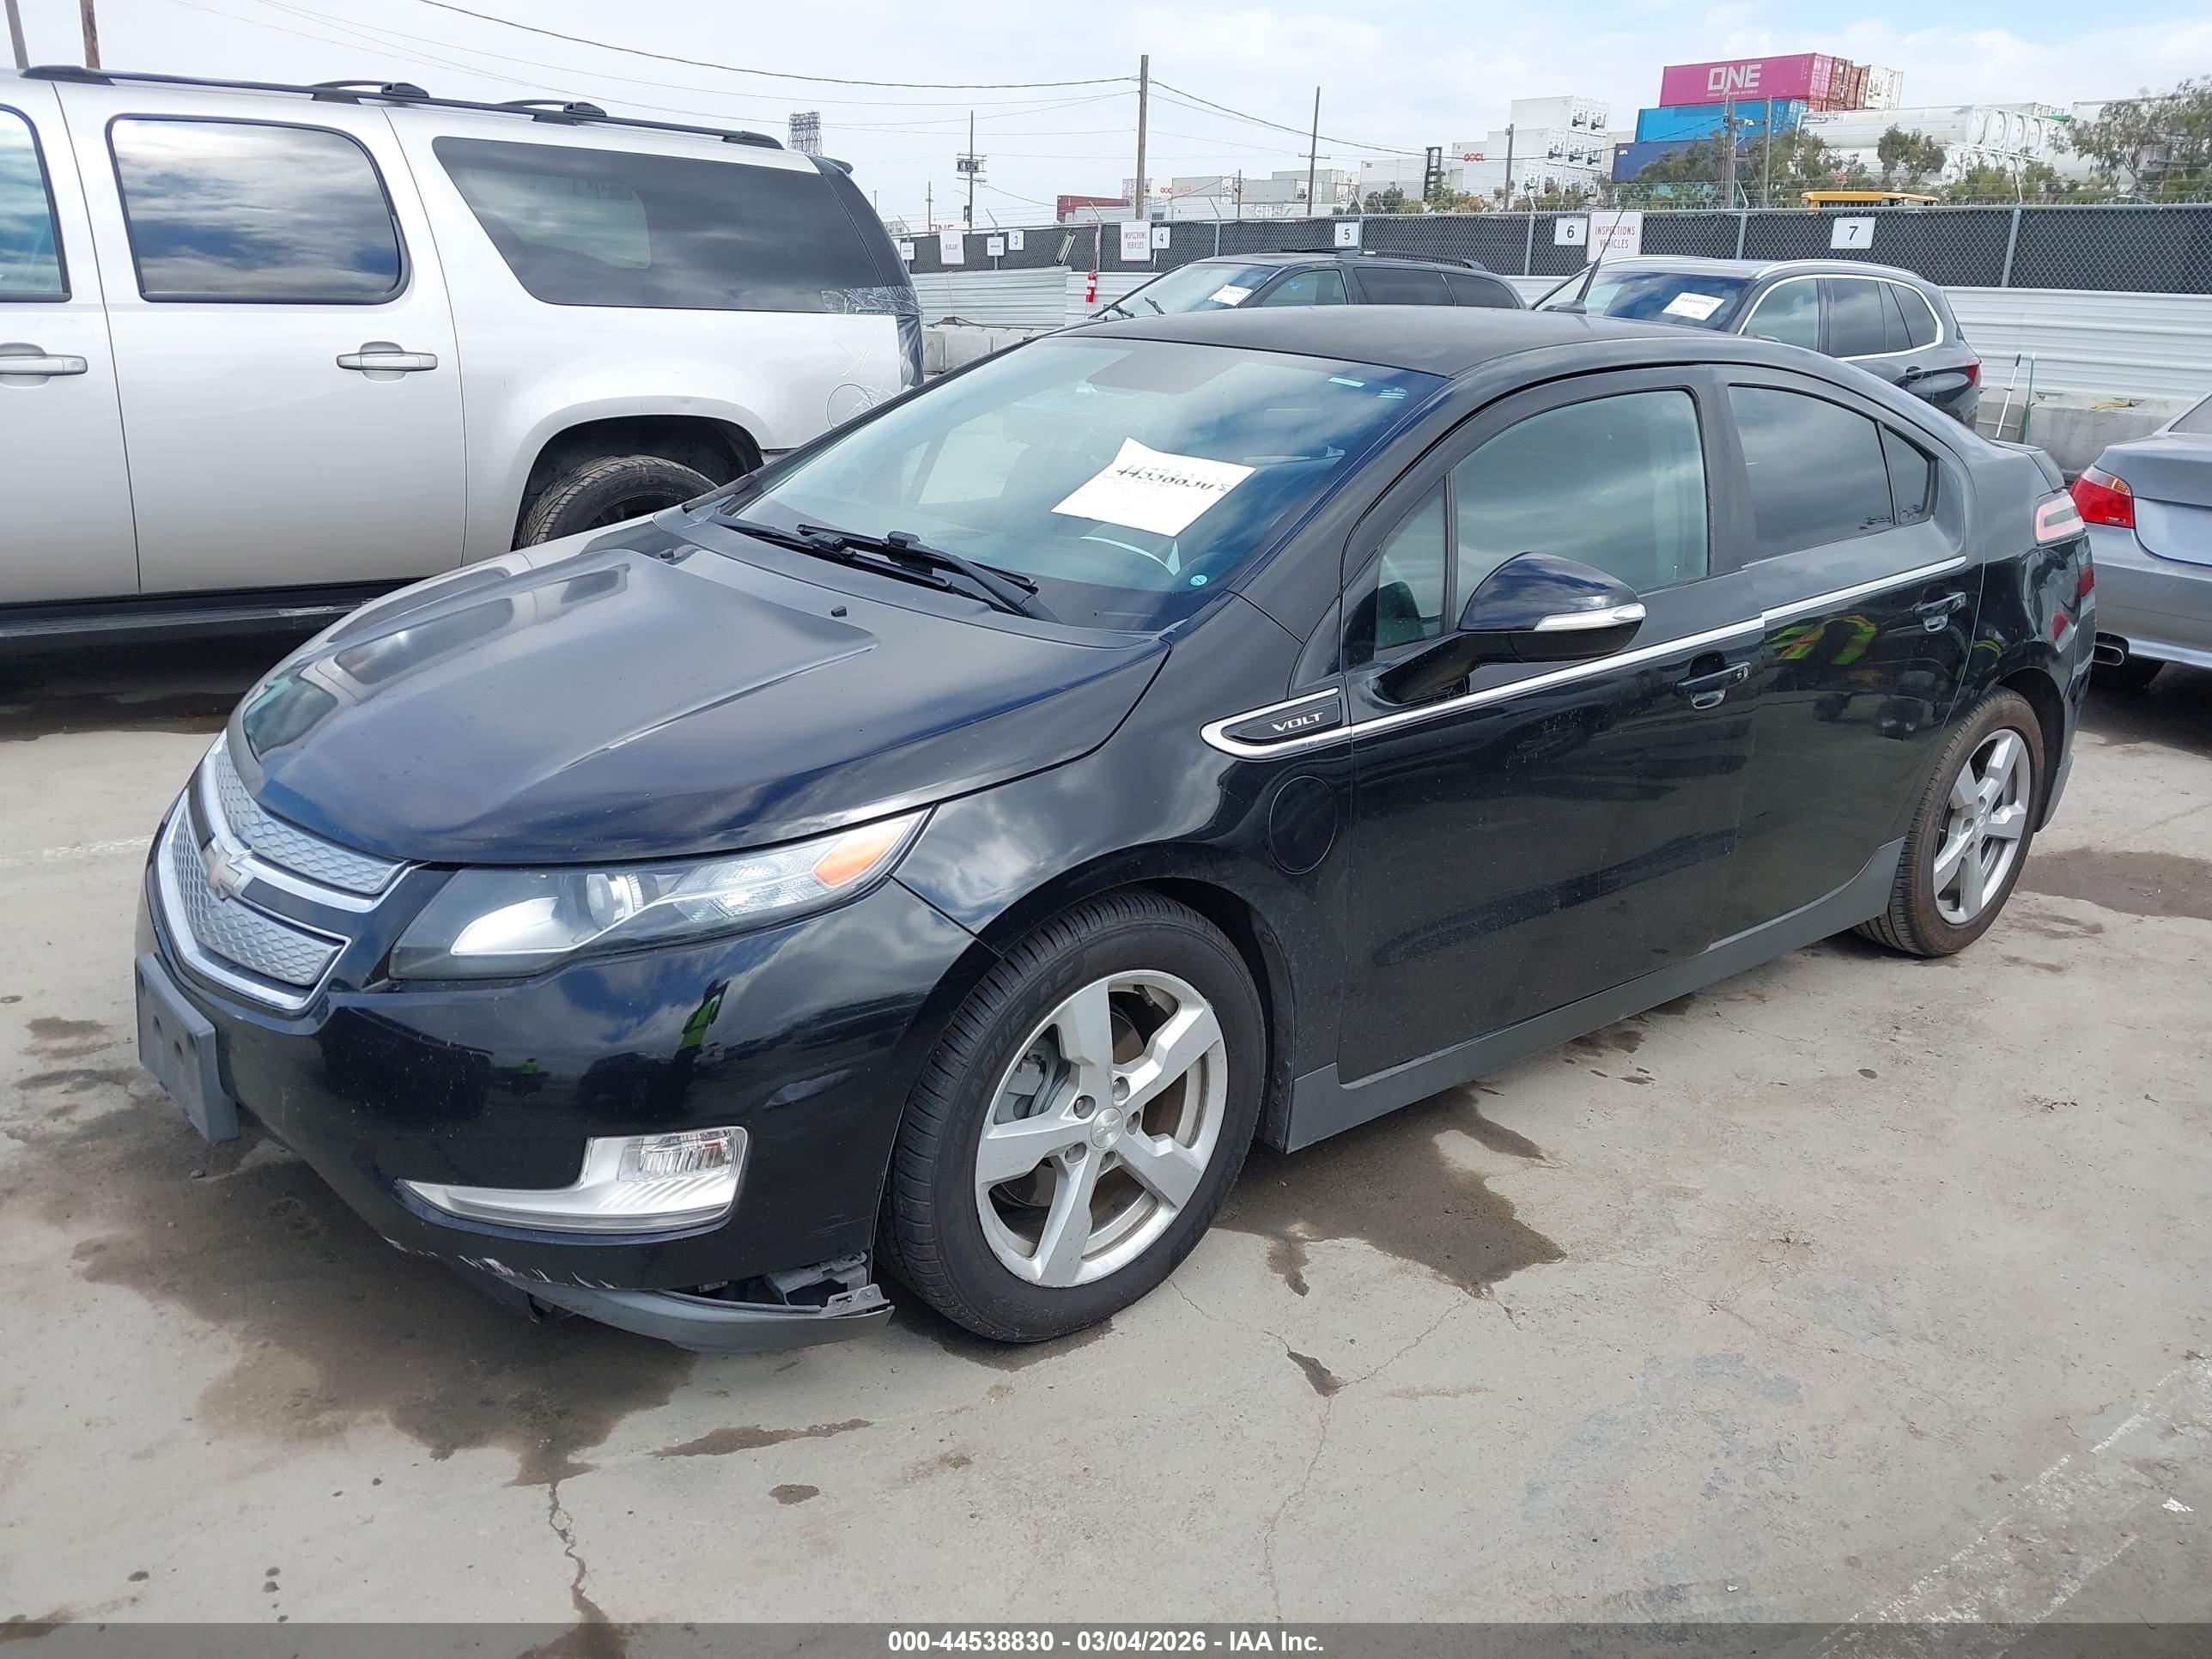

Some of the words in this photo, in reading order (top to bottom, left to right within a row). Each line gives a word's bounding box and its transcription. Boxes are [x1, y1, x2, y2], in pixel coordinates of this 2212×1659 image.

[1707, 64, 1762, 91] ONE
[1344, 228, 1351, 240] 5
[1566, 225, 1575, 239] 6
[1595, 225, 1636, 236] INSPECTIONS
[1849, 225, 1859, 241] 7
[1013, 235, 1019, 246] 3
[1158, 233, 1164, 244] 4
[1599, 239, 1630, 249] VEHICLES
[1271, 712, 1324, 732] VOLT
